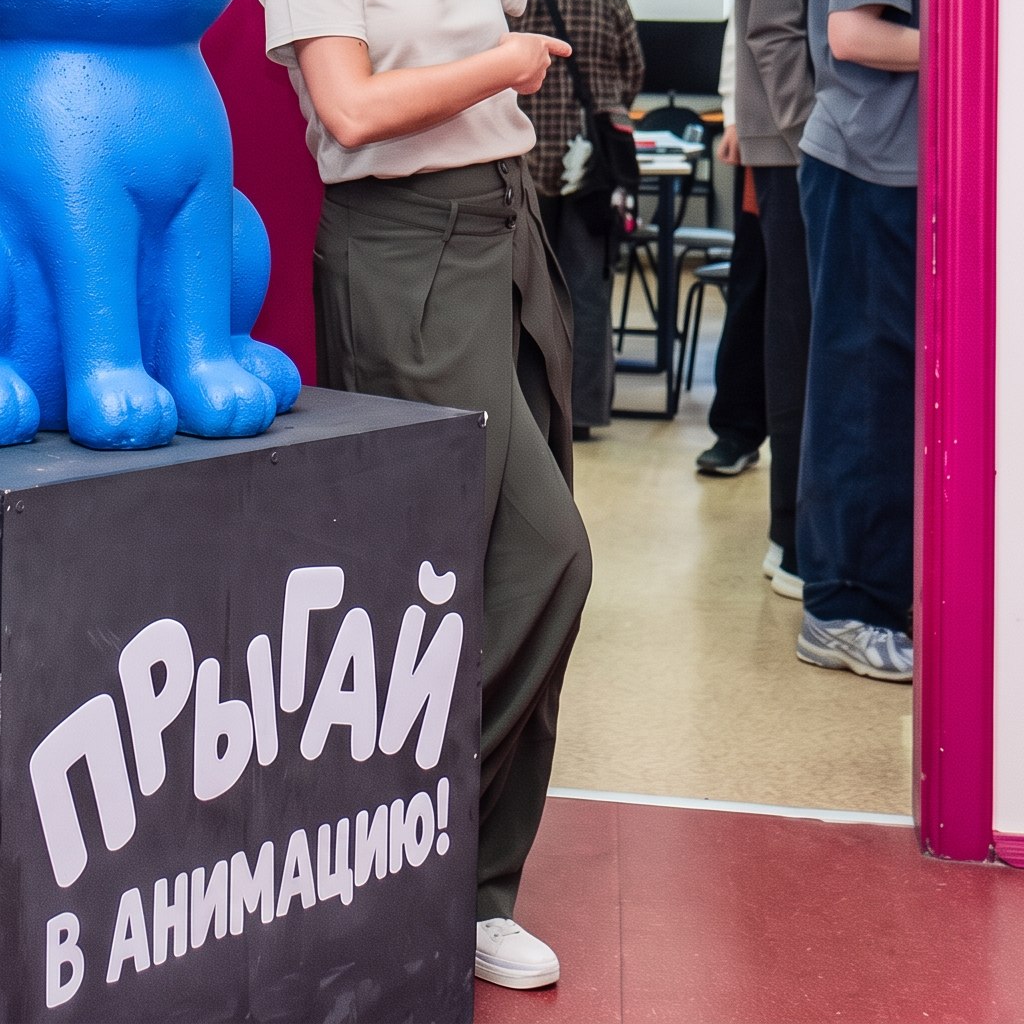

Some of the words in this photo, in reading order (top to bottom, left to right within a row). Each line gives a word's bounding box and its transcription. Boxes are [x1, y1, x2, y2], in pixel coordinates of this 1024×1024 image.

[29, 560, 464, 888] ПРЫГАЙ
[45, 911, 85, 1008] В
[106, 777, 450, 983] АНИМАЦИЮ!
